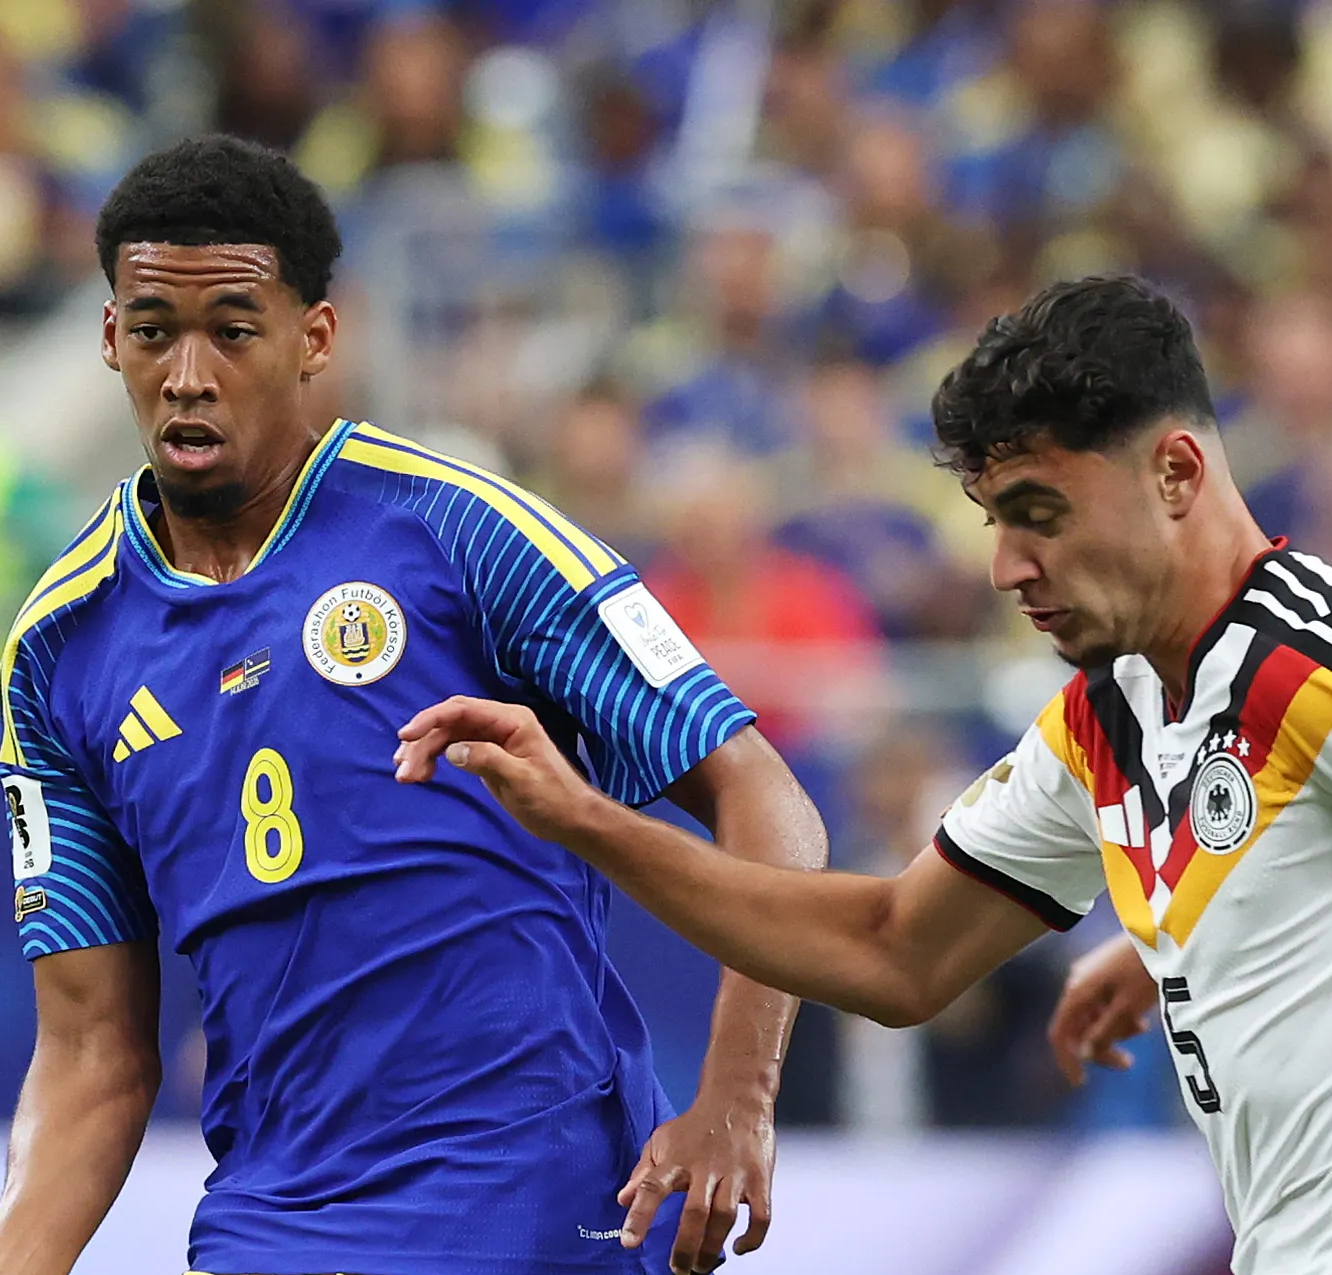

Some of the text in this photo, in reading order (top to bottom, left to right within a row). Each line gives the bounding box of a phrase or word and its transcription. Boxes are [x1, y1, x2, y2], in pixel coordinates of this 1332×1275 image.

[311, 596, 338, 674] Federashon
[650, 638, 681, 660] PEACE
[241, 747, 303, 883] 8
[1162, 976, 1223, 1114] 5
